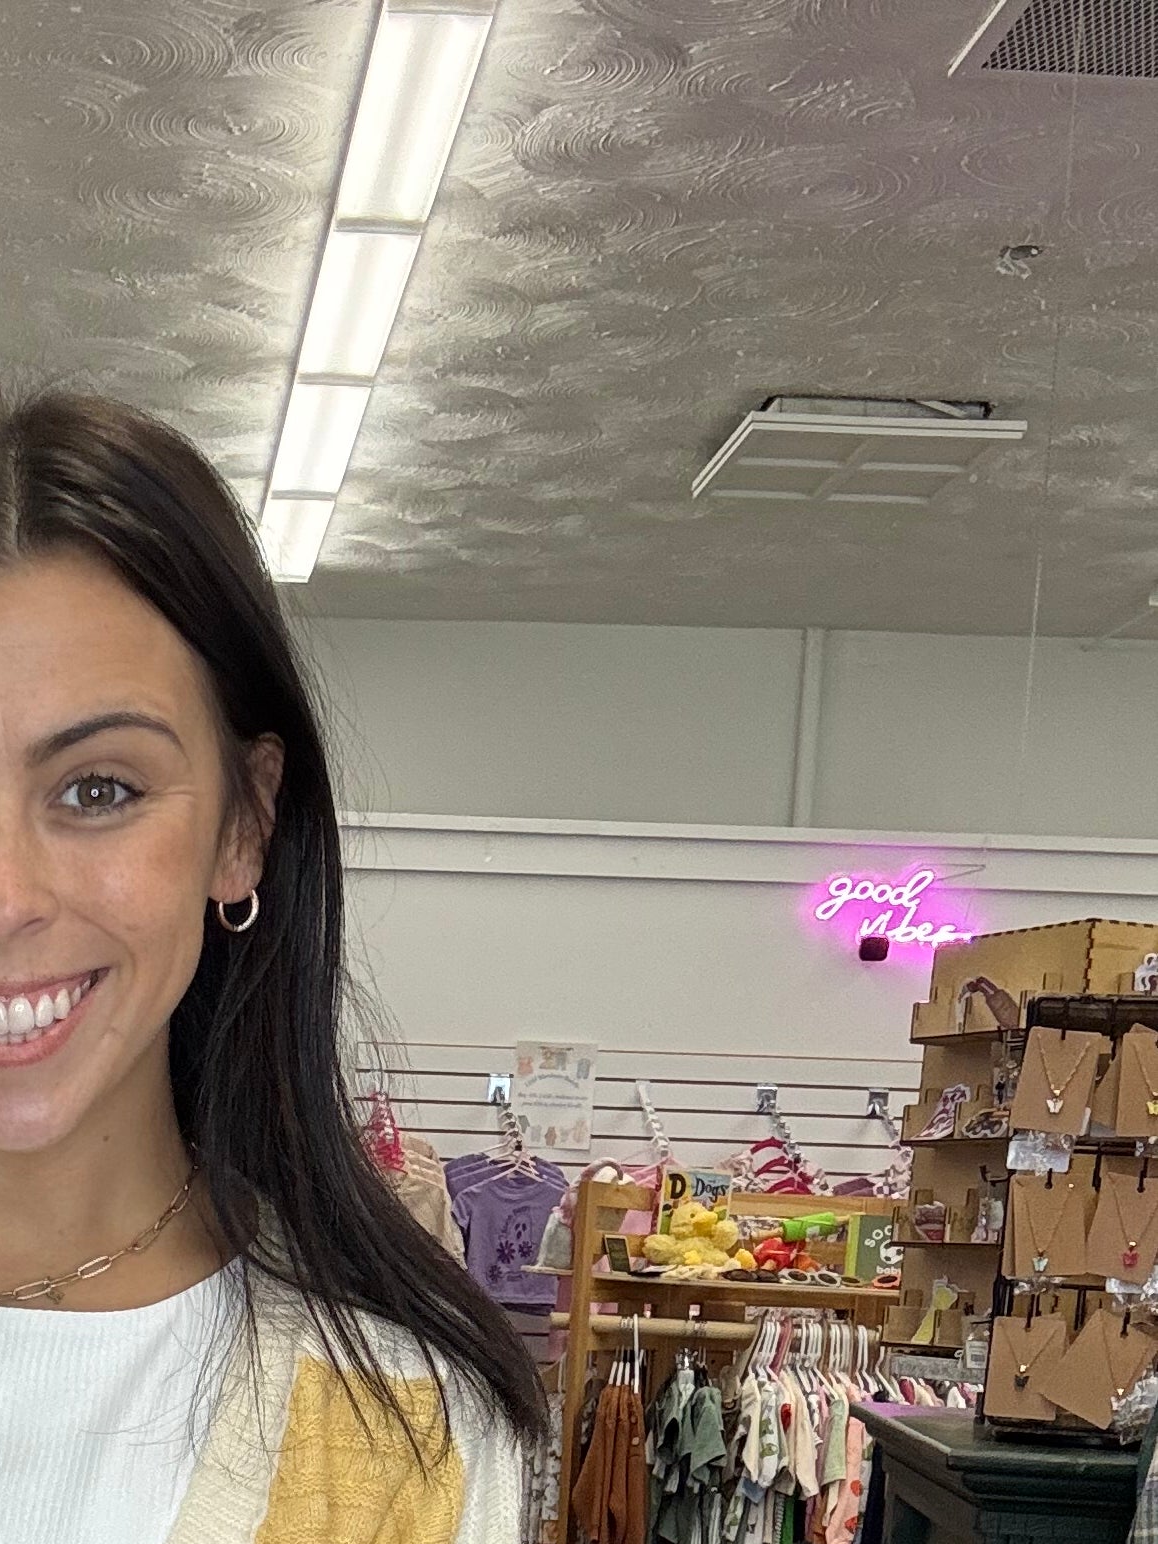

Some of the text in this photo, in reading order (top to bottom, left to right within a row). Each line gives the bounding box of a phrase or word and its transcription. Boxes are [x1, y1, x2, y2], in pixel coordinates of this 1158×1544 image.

[815, 869, 936, 921] good
[668, 1173, 730, 1204] D Dogs
